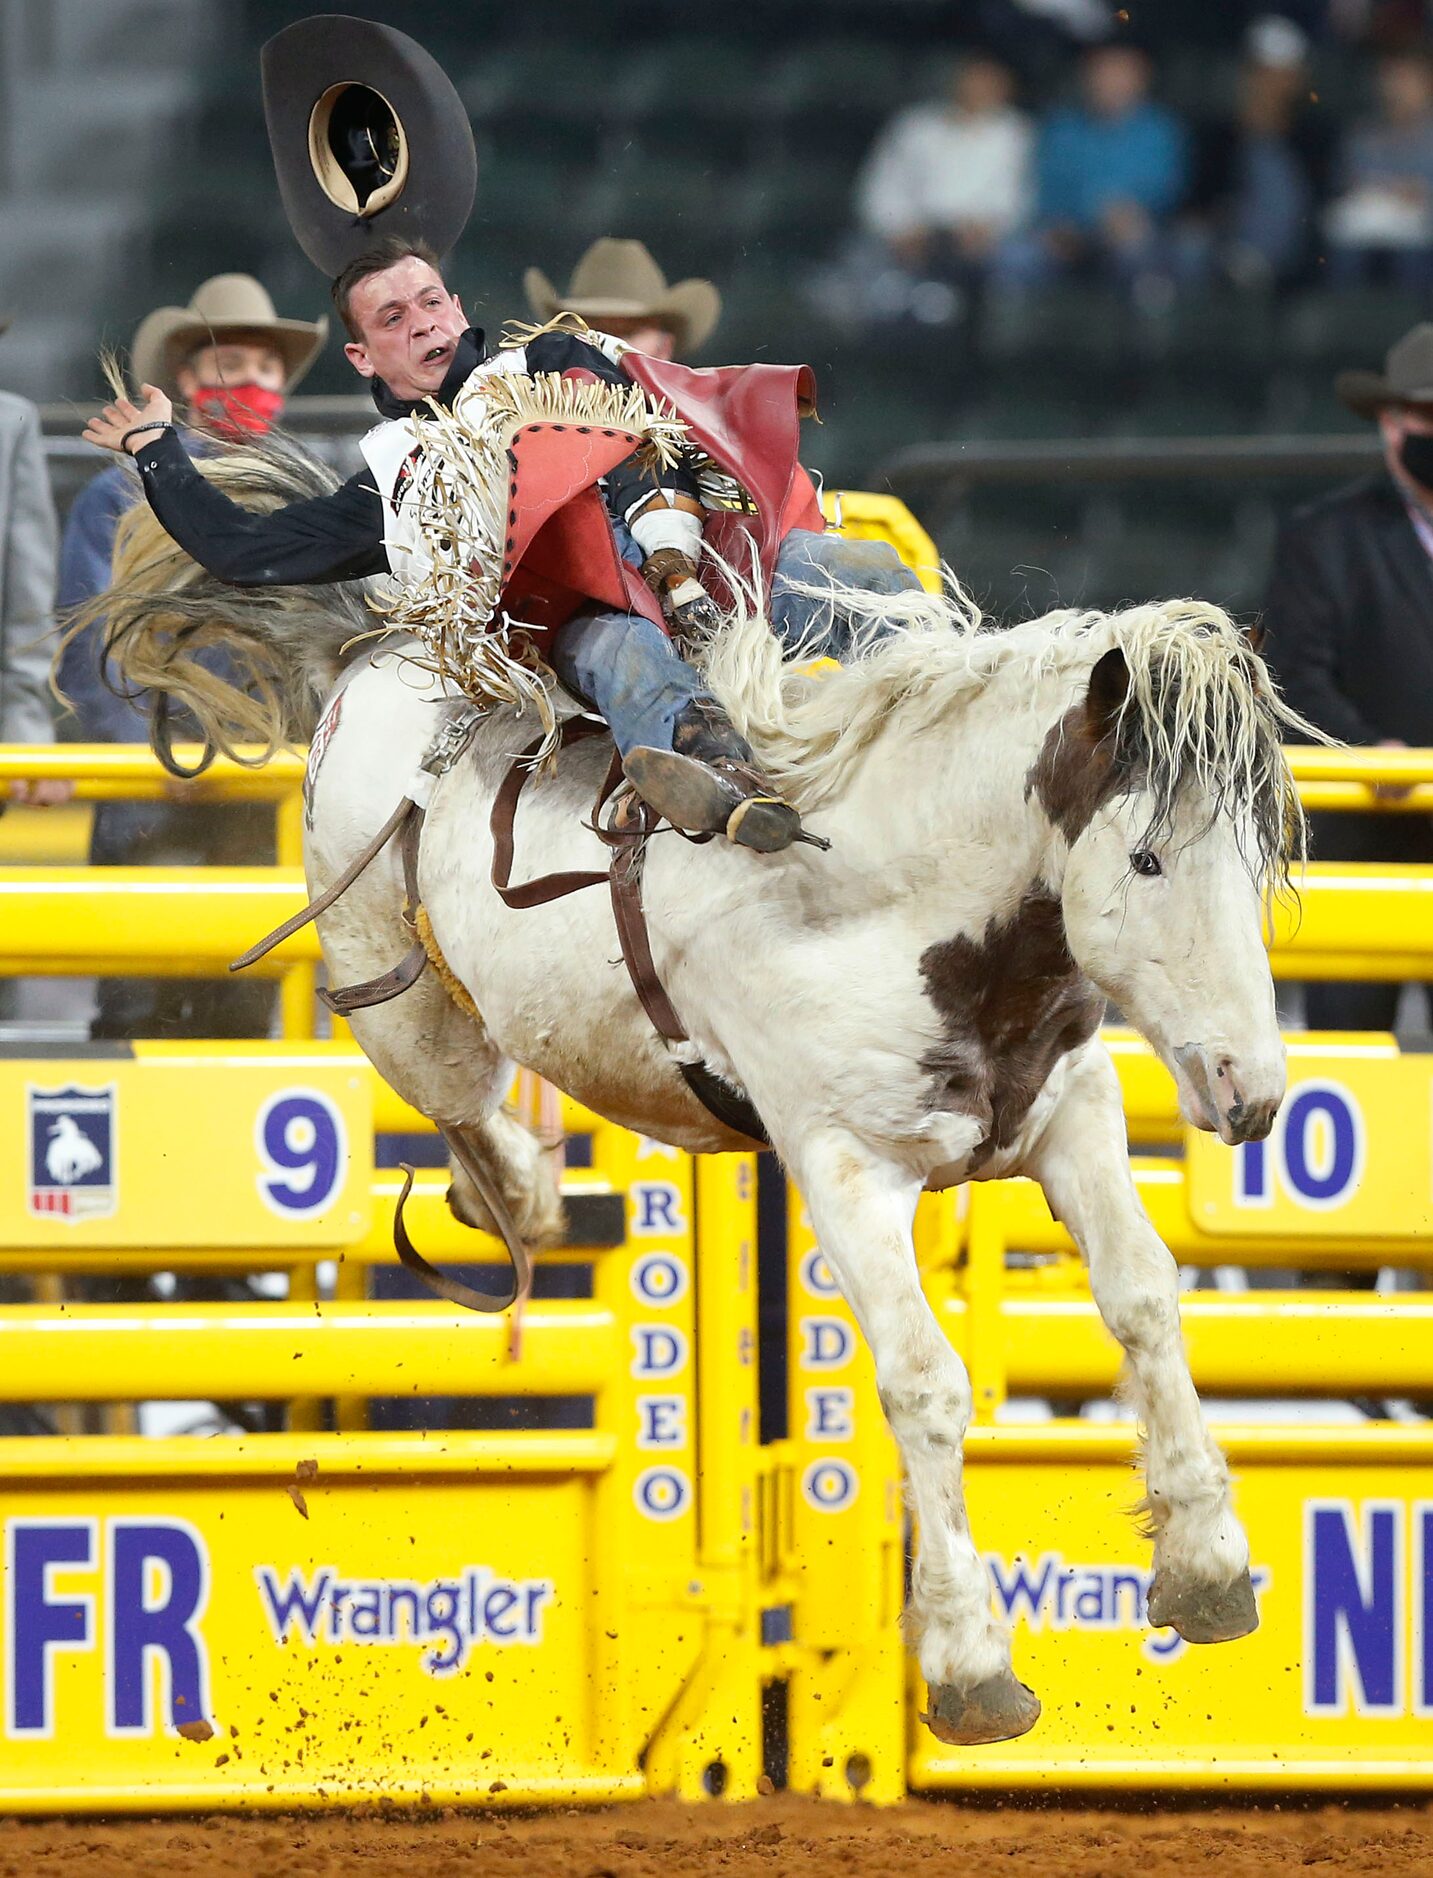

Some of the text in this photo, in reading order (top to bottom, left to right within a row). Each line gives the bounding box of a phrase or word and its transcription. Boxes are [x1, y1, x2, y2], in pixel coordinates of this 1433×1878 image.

[265, 1098, 339, 1210] 9
[638, 1186, 684, 1514] RODEO
[262, 1573, 547, 1669] Wrangler
